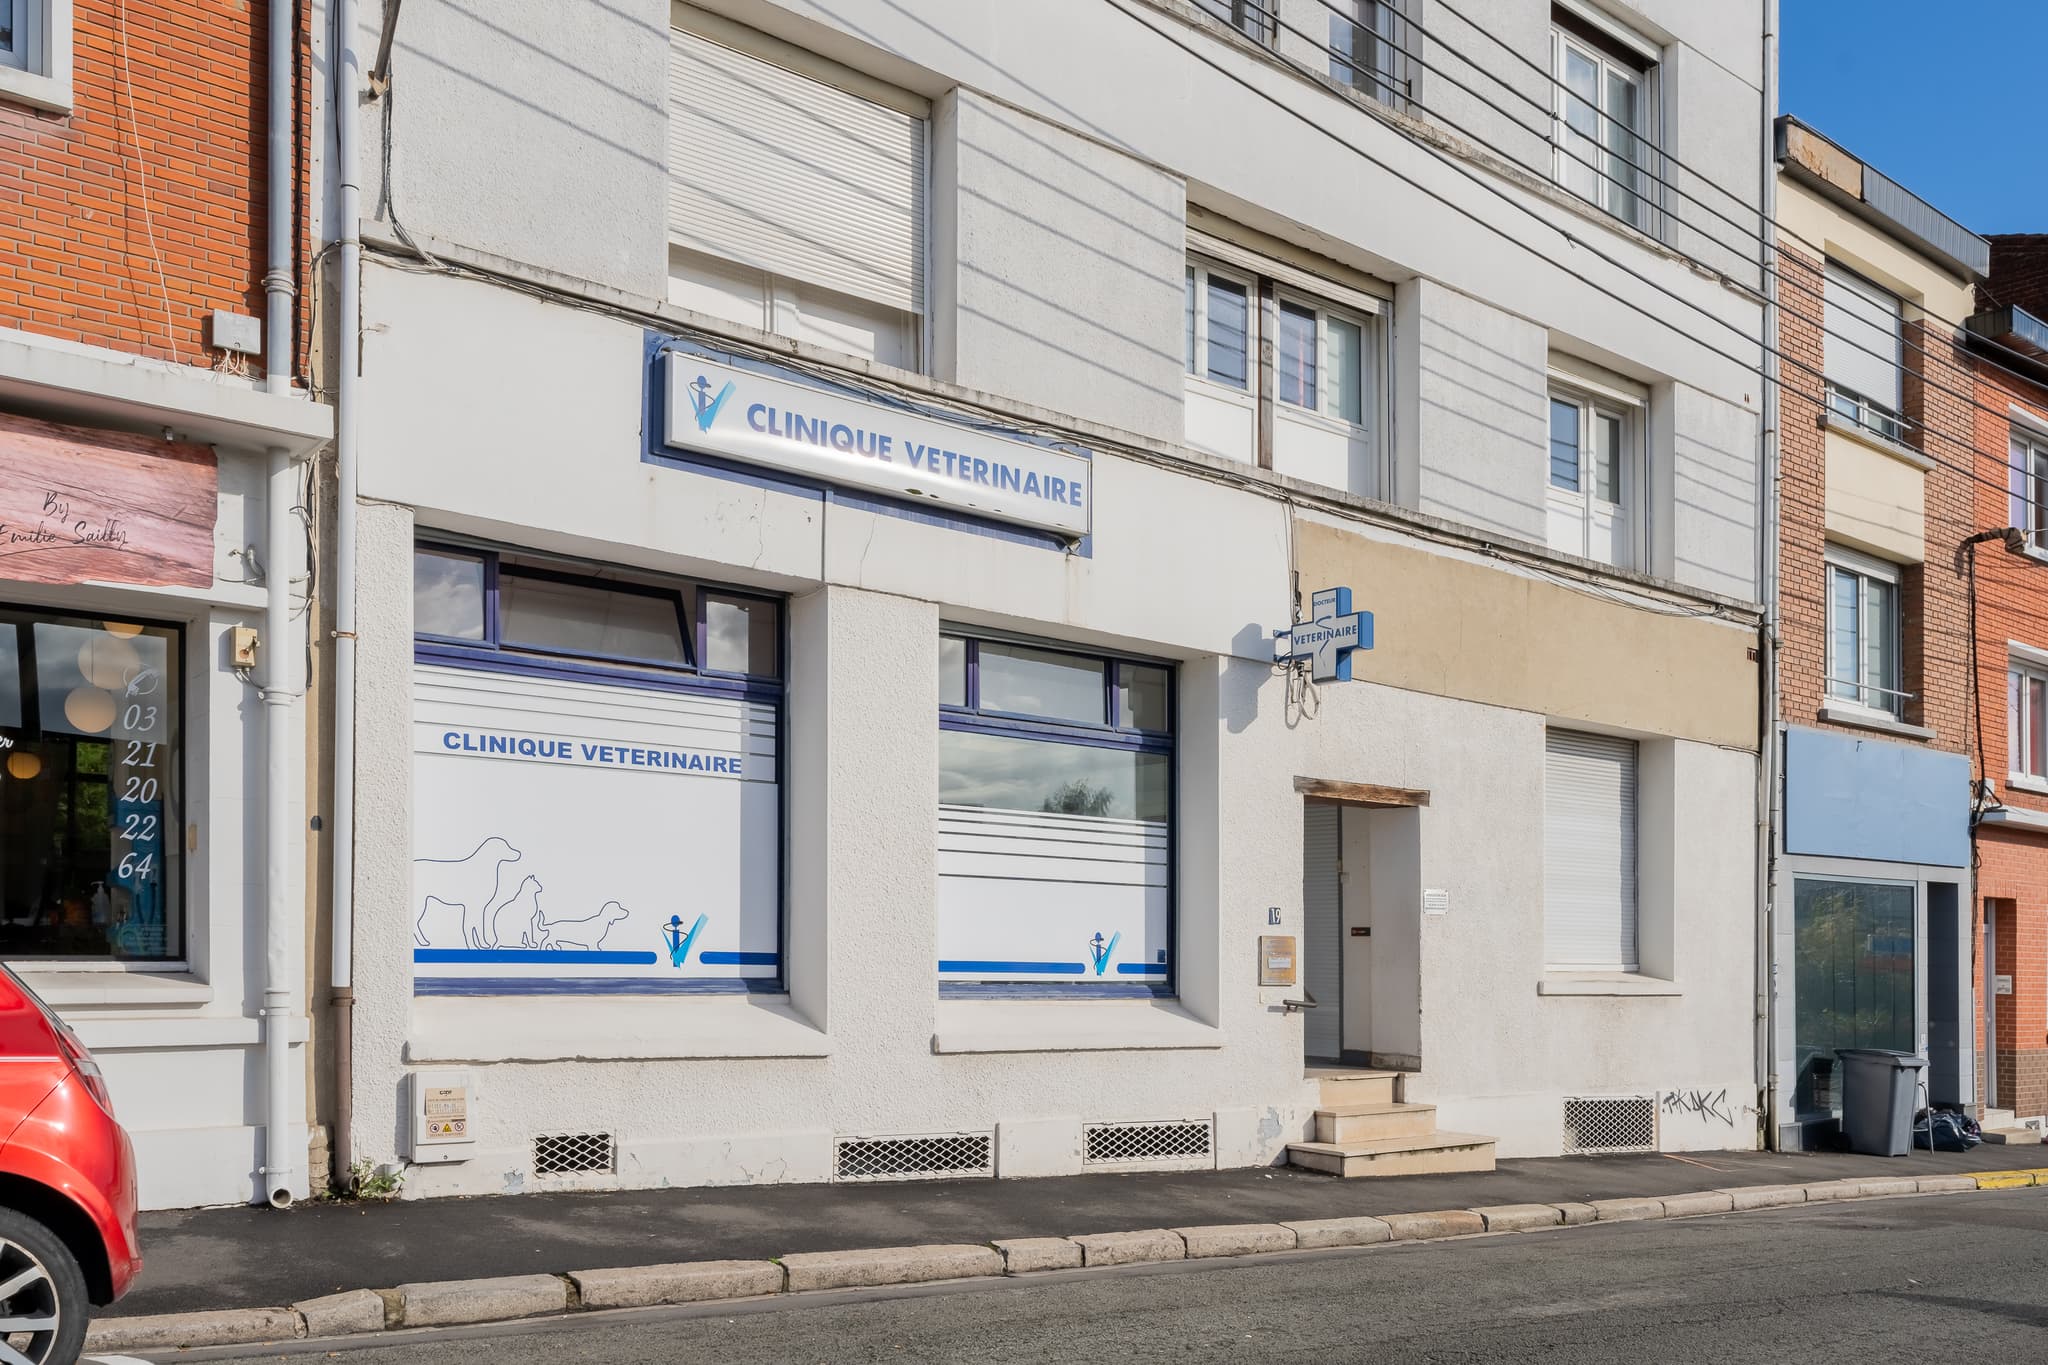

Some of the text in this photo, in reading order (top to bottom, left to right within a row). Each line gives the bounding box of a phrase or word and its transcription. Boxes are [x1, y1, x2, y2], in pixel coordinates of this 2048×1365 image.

[747, 403, 1082, 508] CLINIQUE VETERINAIRE
[43, 492, 69, 523] By
[1294, 625, 1357, 645] VETERINAIRE
[123, 704, 157, 731] 03
[122, 741, 156, 768] 21
[443, 731, 742, 775] CLINIQUE VETERINAIRE
[121, 777, 157, 804] 20
[120, 814, 156, 841] 22
[118, 852, 152, 880] 64
